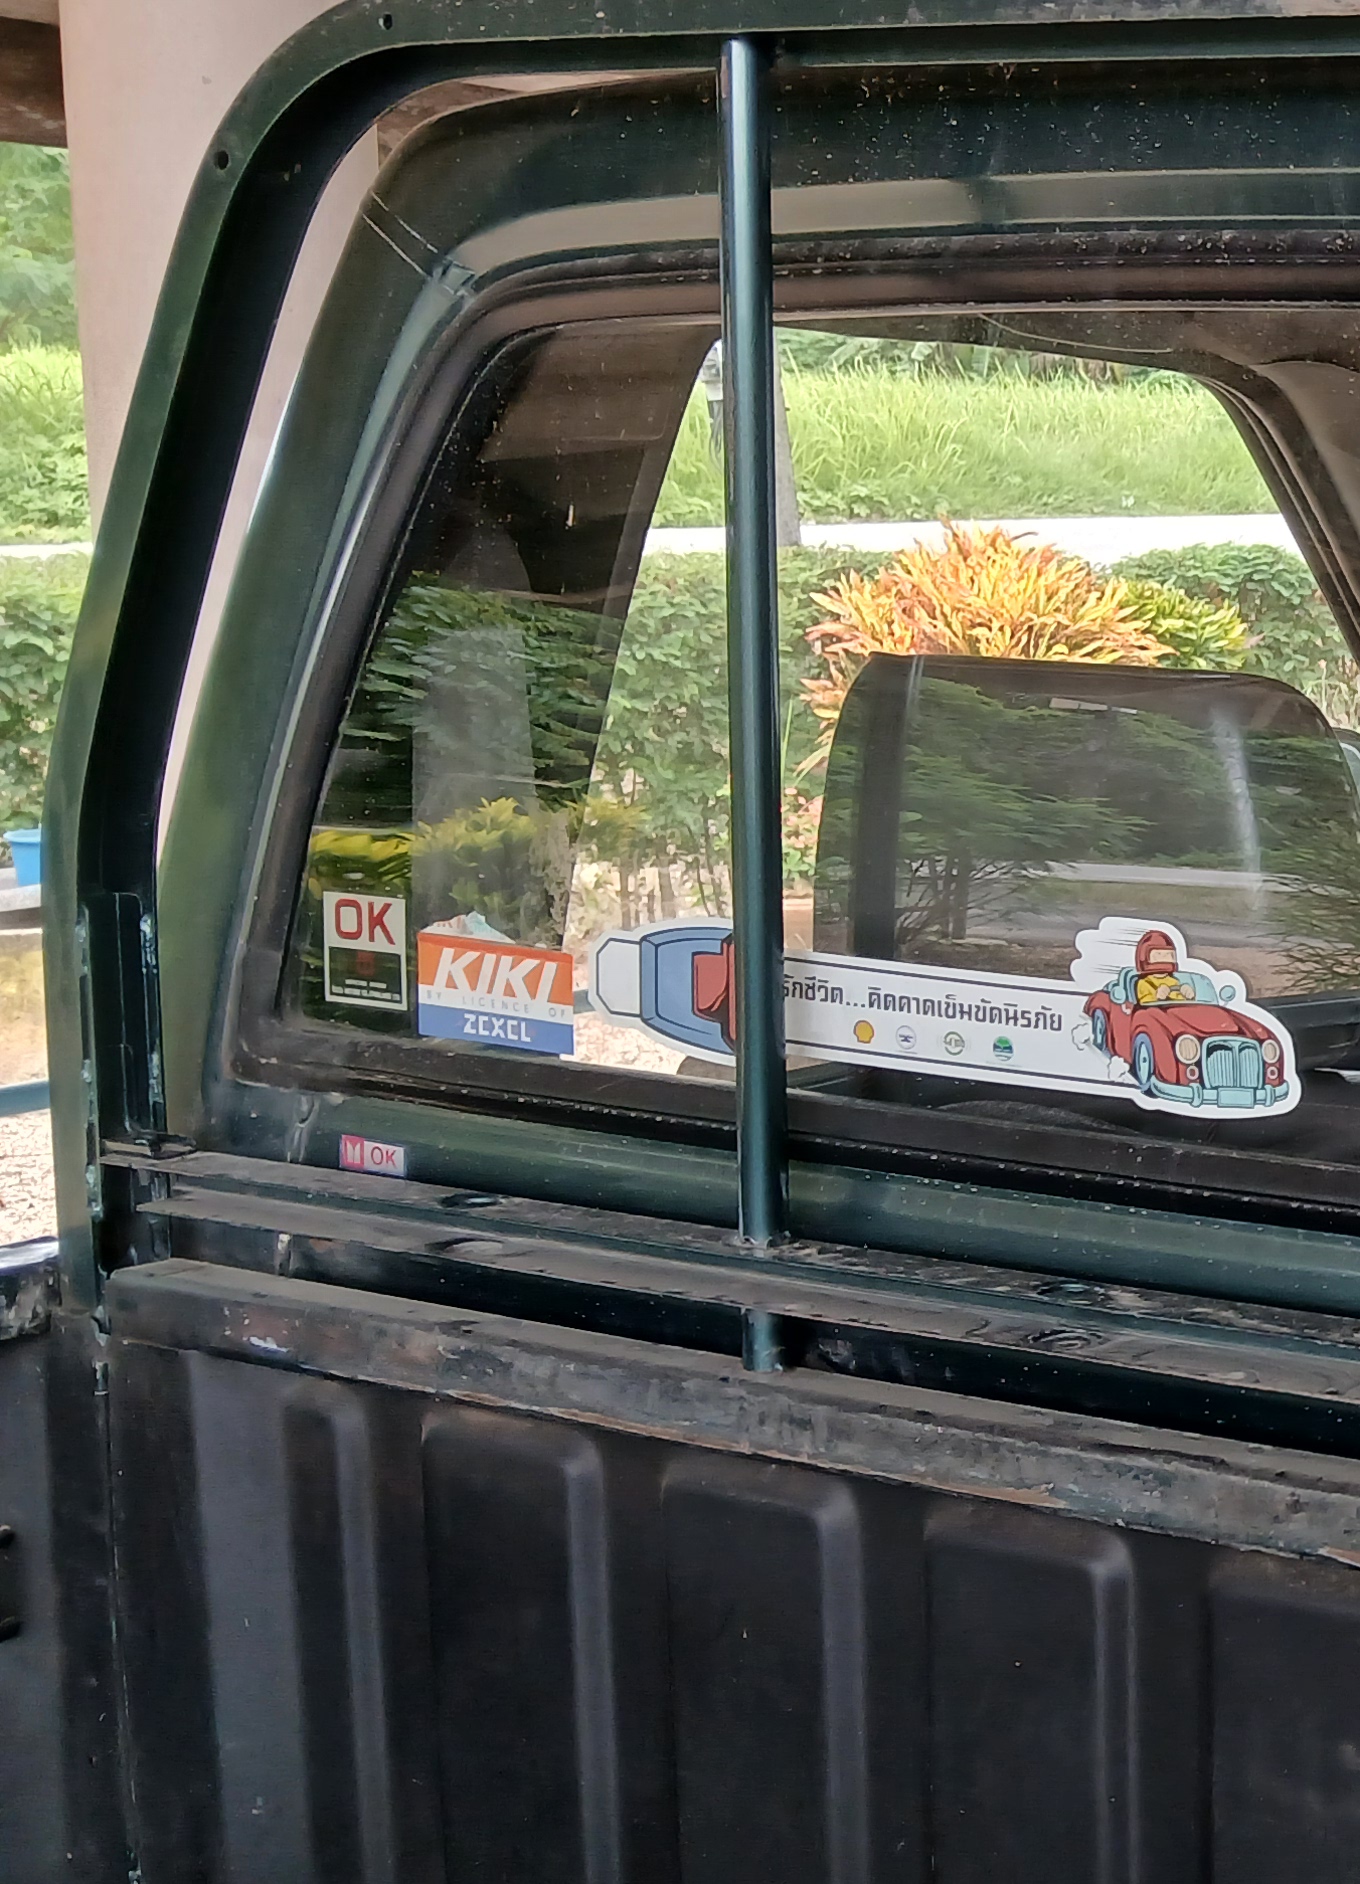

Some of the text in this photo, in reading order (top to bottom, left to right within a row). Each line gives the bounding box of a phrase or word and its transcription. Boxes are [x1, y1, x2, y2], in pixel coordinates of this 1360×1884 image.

[334, 898, 396, 946] OK
[433, 947, 559, 1003] KIKI
[426, 990, 565, 1018] BY LICENCE OF
[371, 1146, 397, 1168] OK
